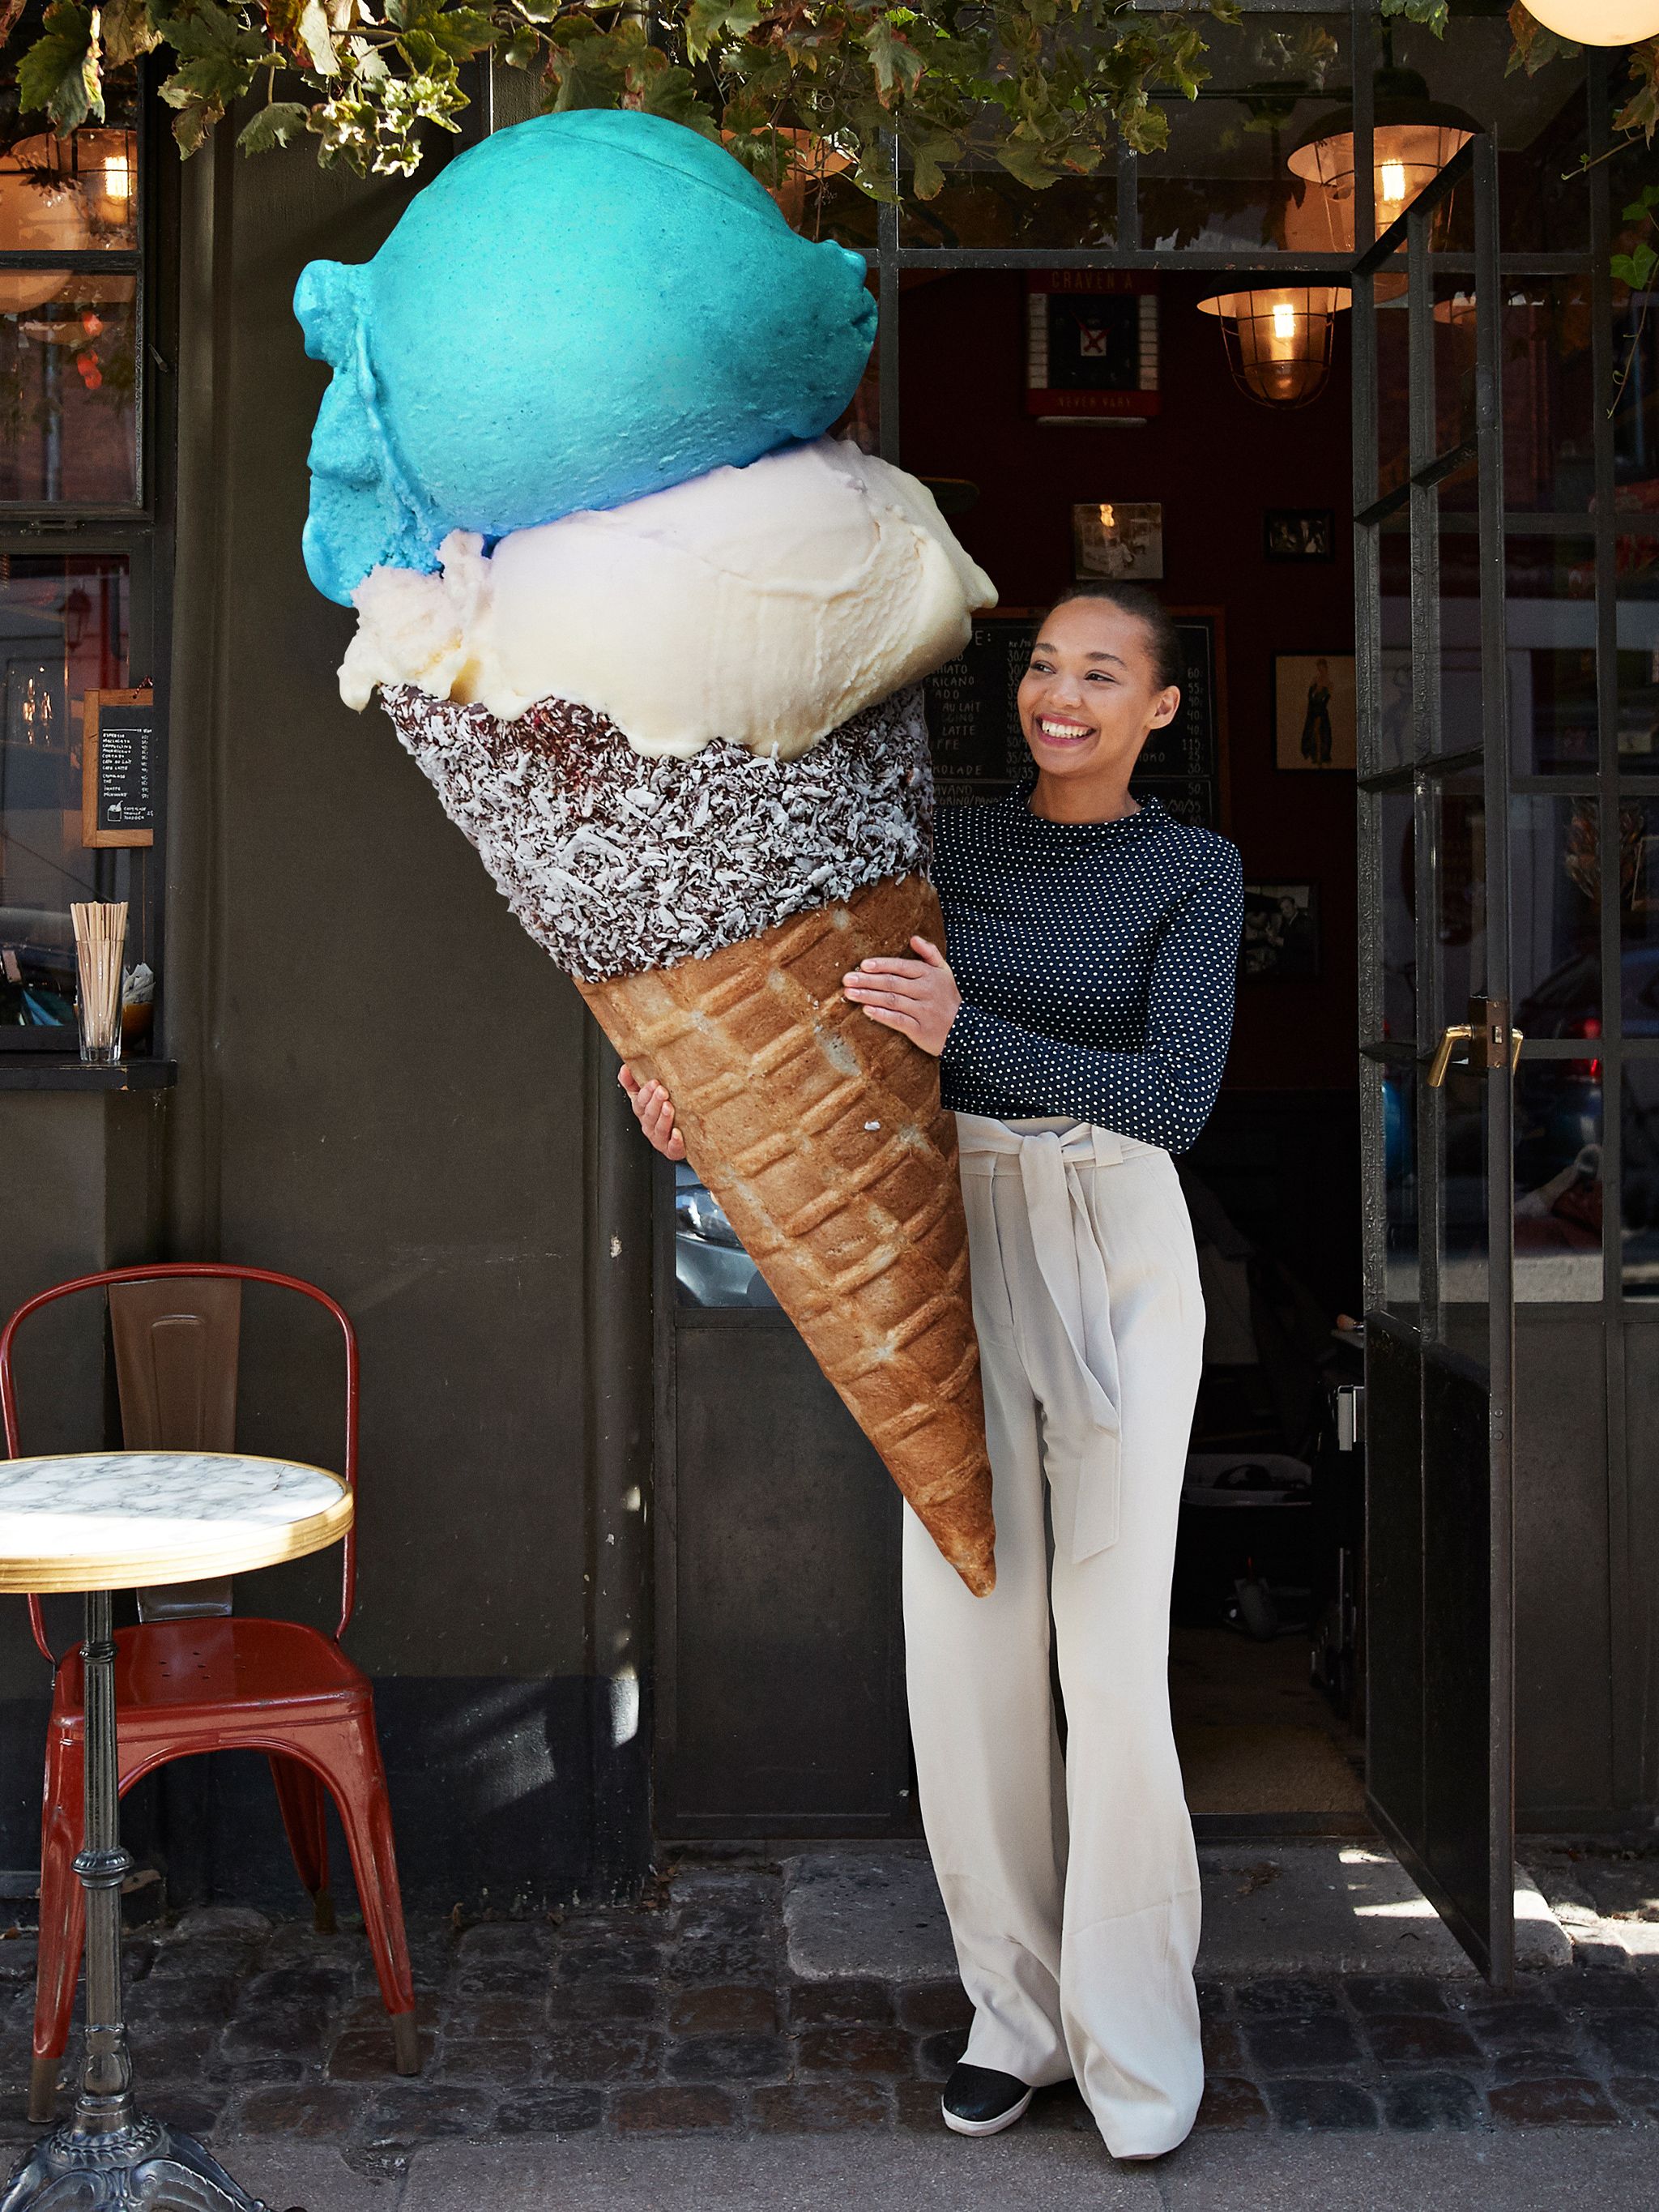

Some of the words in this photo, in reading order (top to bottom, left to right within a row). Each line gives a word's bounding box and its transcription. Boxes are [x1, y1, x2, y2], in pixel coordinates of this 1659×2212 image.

[1051, 271, 1115, 288] CRAVEN
[1124, 271, 1132, 288] A
[942, 725, 976, 736] LATTE
